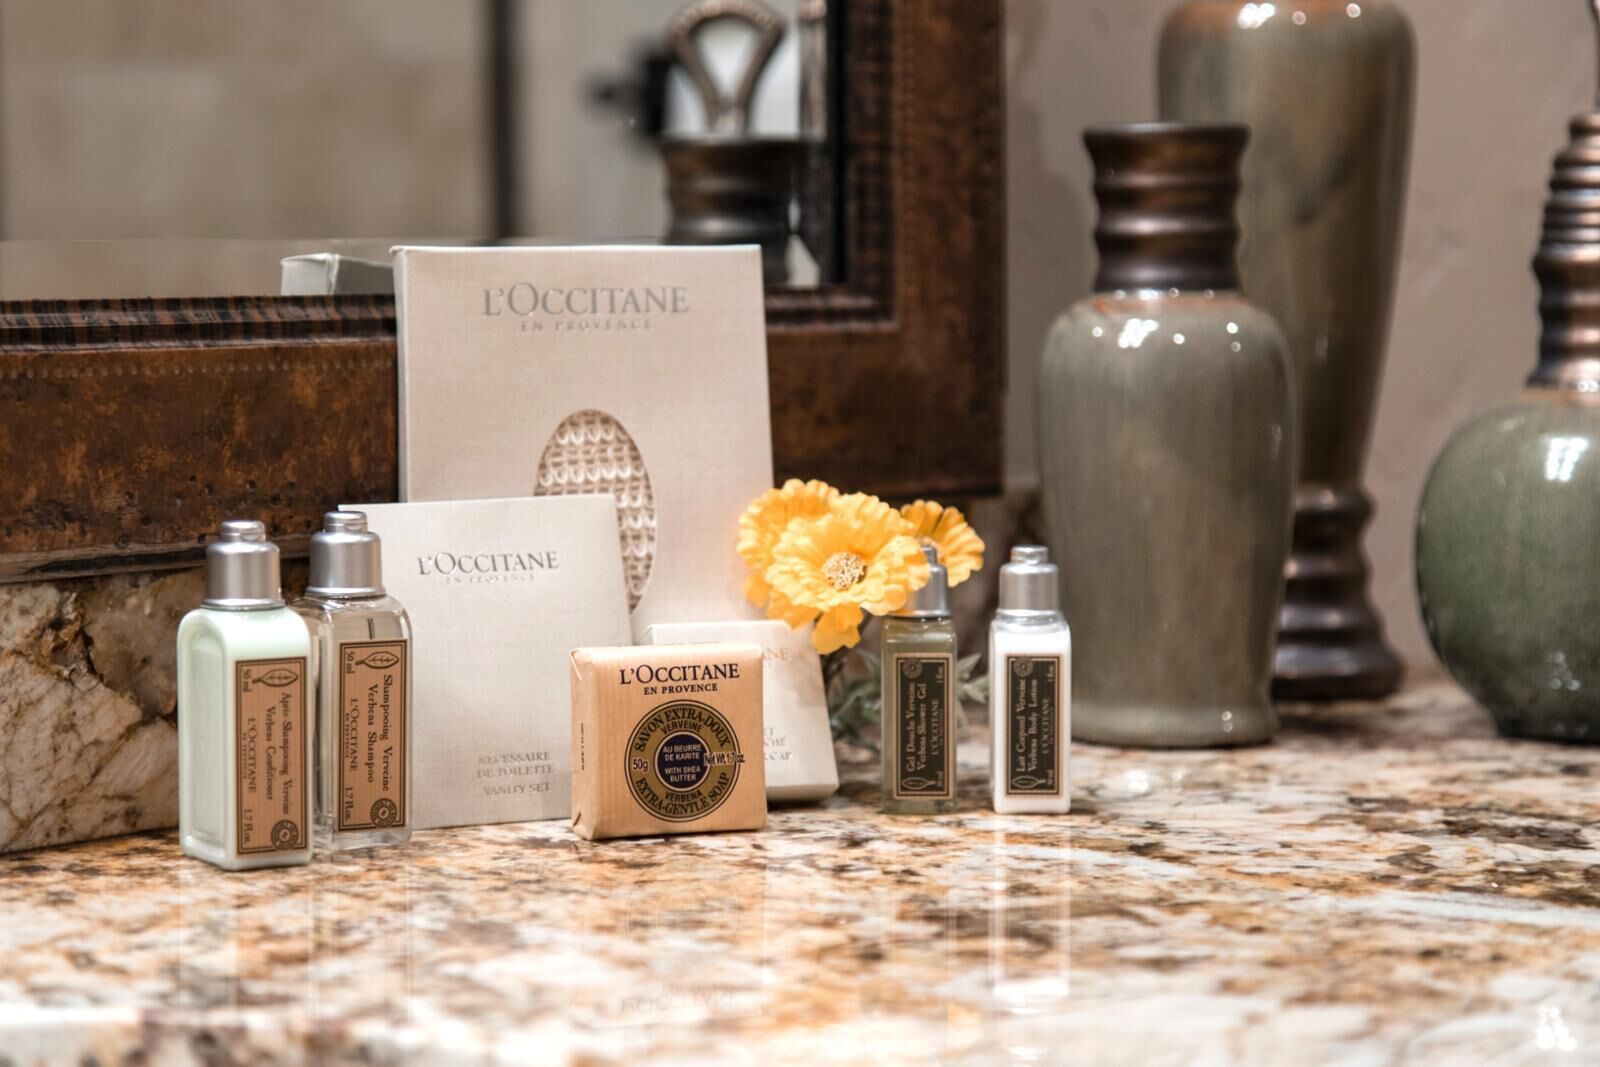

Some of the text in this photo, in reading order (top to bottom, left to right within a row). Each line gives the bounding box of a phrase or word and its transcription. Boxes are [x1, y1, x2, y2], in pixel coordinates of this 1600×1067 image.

[482, 281, 690, 317] L'OCCITANE
[521, 319, 652, 332] EN PROVENCE
[417, 551, 560, 575] L'OCCITANE
[346, 651, 355, 674] 50 ml
[619, 663, 740, 685] L'OCCITANE
[643, 683, 718, 695] EN PROVENCE
[917, 684, 926, 699] Gel
[1016, 679, 1026, 712] Verveine
[379, 674, 392, 741] Shampooing
[917, 704, 926, 734] Shower
[350, 698, 360, 772] L'OCCITANE
[364, 684, 378, 783] Verbena Shampoo
[634, 707, 731, 752] SAVON EXTRA-DOUX
[660, 720, 703, 734] VERVEINE
[906, 720, 916, 752] Douche
[1016, 716, 1028, 753] Corporel
[1028, 680, 1039, 771] Verbena Body Lotion
[248, 718, 257, 793] L'OCCITANE
[265, 706, 277, 800] Verbena Conditioner
[663, 744, 702, 753] AU BEURRE
[664, 753, 674, 761] DE
[383, 746, 393, 791] Verveine
[633, 759, 648, 772] 50g
[683, 765, 701, 773] SHEA
[906, 758, 916, 772] Gel
[1016, 756, 1025, 771] Lait
[528, 782, 552, 793] SET
[670, 774, 697, 782] BUTTER
[636, 772, 729, 815] EXTRA-GENTLE SOAP
[665, 790, 703, 802] VERBENA
